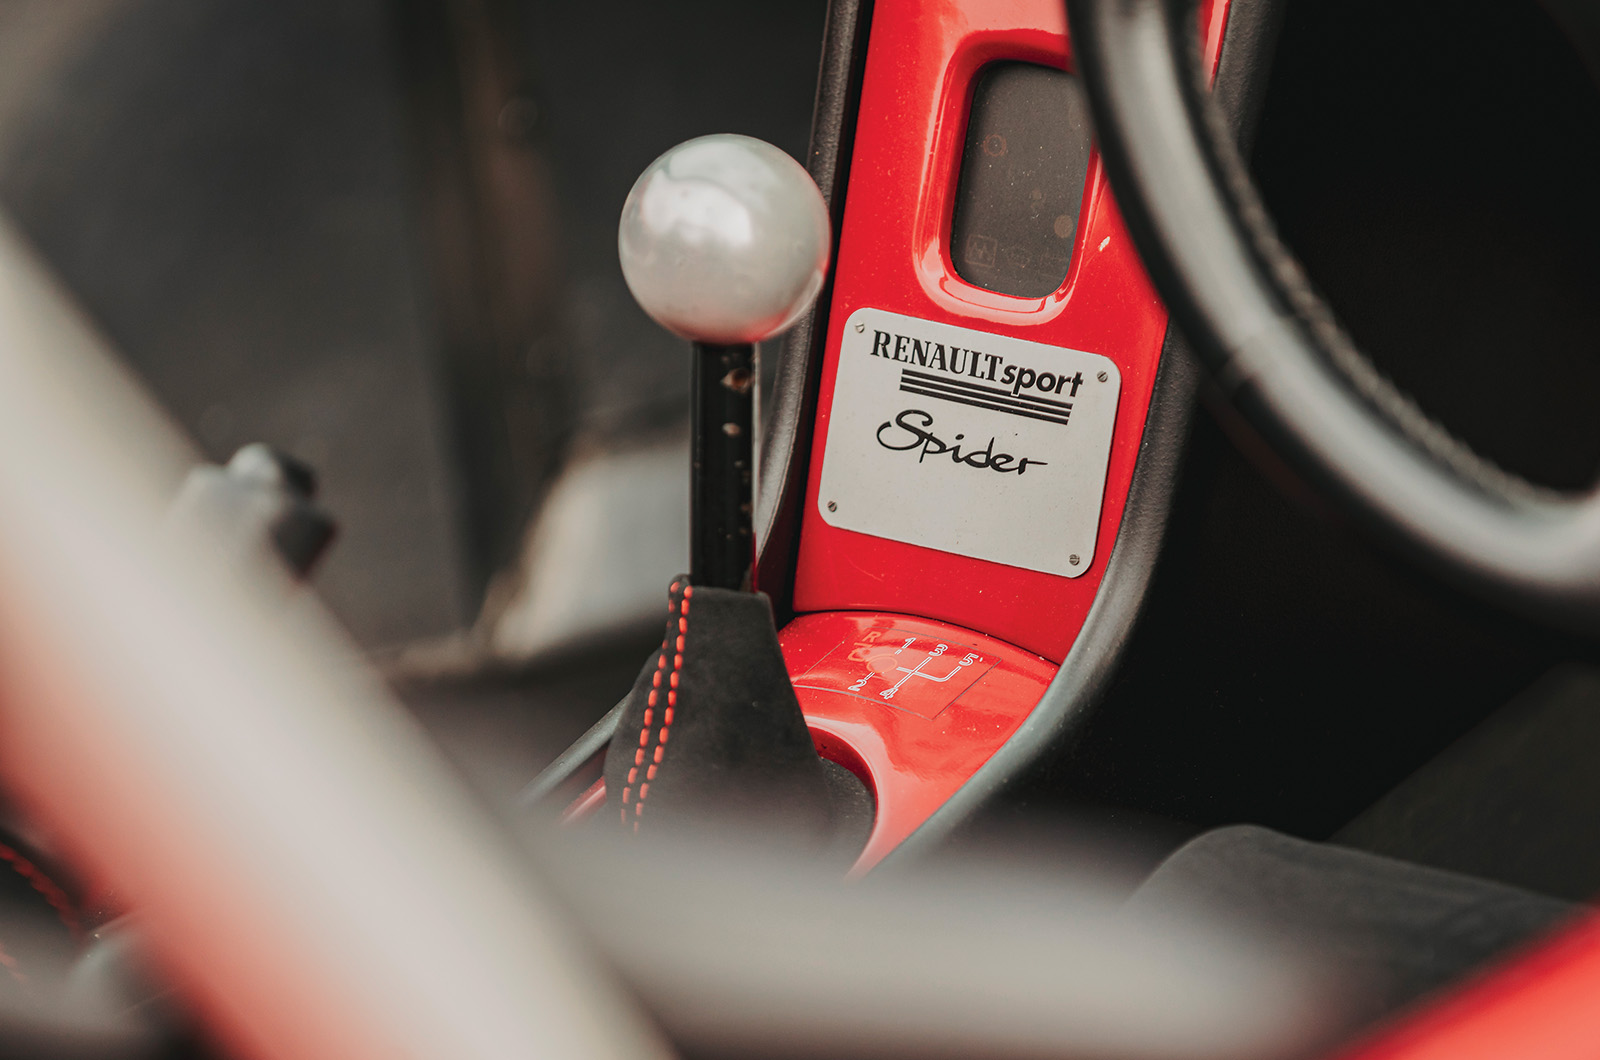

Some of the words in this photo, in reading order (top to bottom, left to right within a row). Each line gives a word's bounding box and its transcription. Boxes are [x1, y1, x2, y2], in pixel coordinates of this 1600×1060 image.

[870, 329, 1084, 397] RENAULTsport
[876, 409, 1048, 476] Spider
[901, 637, 916, 649] 1
[928, 643, 948, 657] 3
[958, 653, 979, 666] 5
[848, 679, 867, 691] 2
[879, 687, 898, 700] 4
